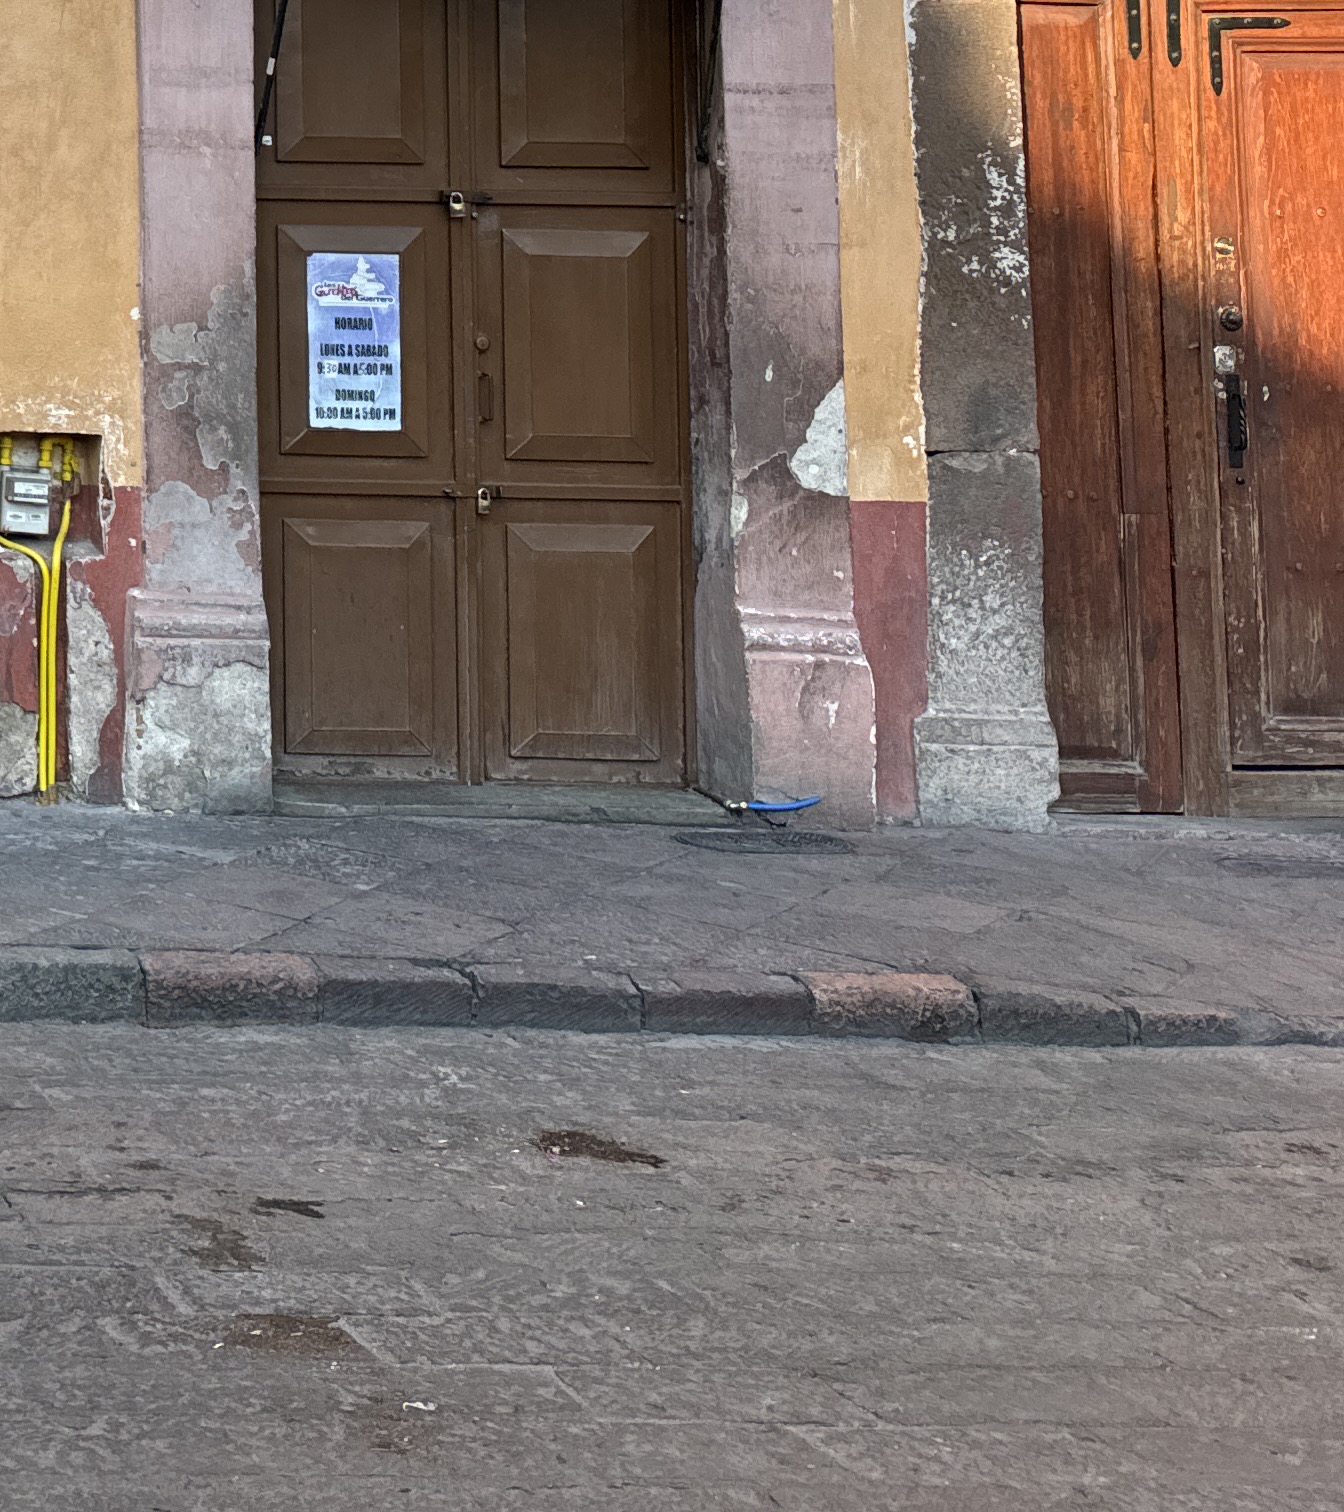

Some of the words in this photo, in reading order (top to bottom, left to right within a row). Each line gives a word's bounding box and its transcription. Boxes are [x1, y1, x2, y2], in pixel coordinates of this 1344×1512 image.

[334, 317, 373, 331] HORARIO
[320, 343, 346, 357] LUNES
[347, 344, 354, 357] A
[380, 363, 393, 376] PM
[335, 389, 376, 402] DOMINGO
[340, 407, 353, 420] AM
[355, 407, 361, 420] A
[383, 408, 396, 421] PM
